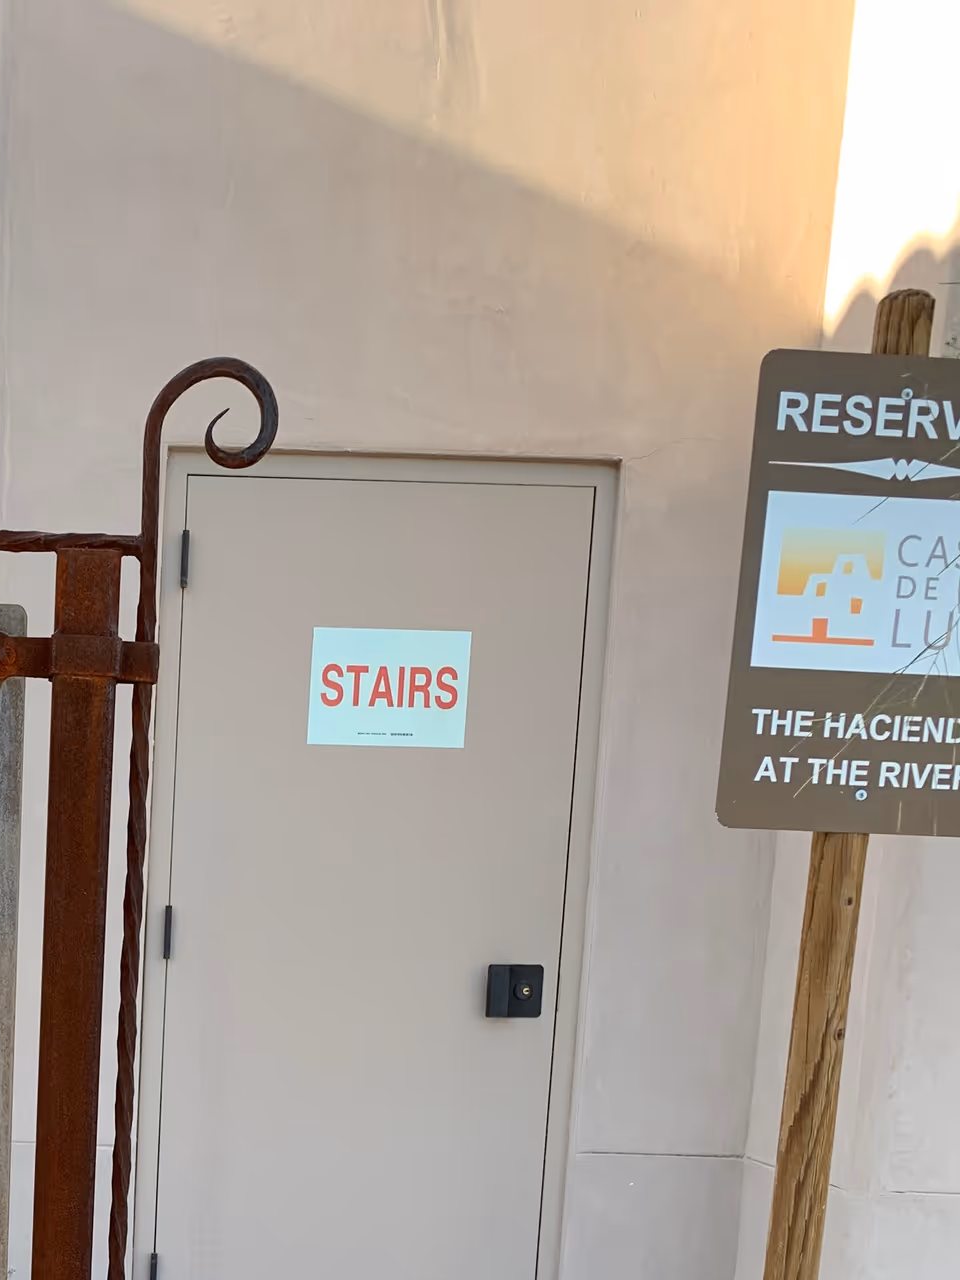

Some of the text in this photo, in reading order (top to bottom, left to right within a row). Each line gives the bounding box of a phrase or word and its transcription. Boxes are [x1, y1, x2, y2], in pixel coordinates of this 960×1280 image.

[897, 535, 960, 569] CA
[896, 575, 940, 600] DE
[320, 663, 459, 710] STAIRS
[751, 708, 815, 738] THE
[753, 756, 799, 783] AT
[807, 758, 870, 787] THE
